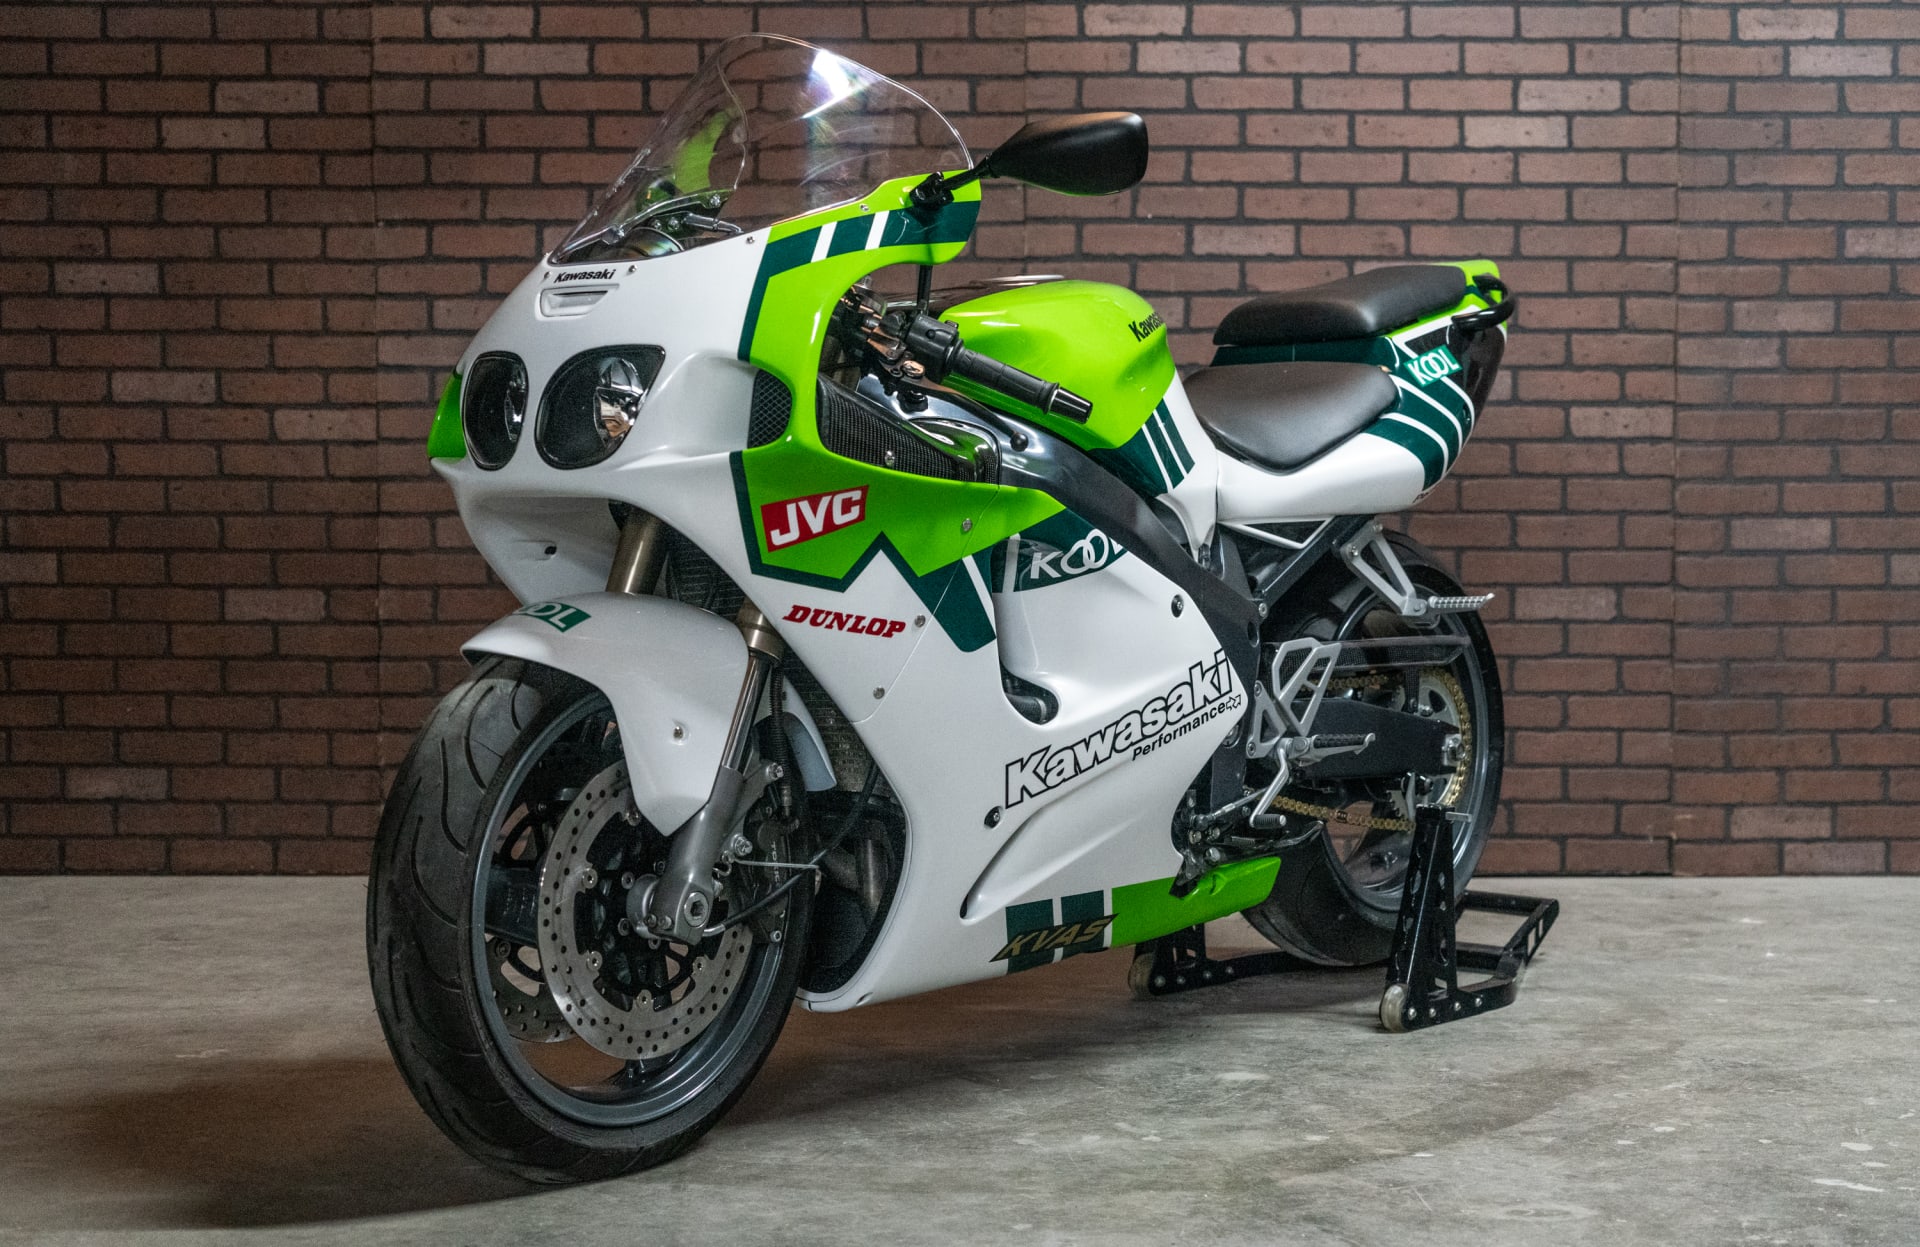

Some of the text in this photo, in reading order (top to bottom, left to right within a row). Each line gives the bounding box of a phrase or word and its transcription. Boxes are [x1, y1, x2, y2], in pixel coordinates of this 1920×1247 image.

[553, 268, 617, 283] Kawasaki
[1128, 311, 1163, 342] Kawas
[1407, 348, 1460, 385] KOOL
[770, 489, 863, 546] JVC
[1030, 528, 1124, 579] KOO
[782, 604, 906, 638] DUNLOP
[1005, 647, 1233, 809] Kawasaki
[1131, 701, 1226, 761] Performance
[999, 917, 1112, 957] KVAS
